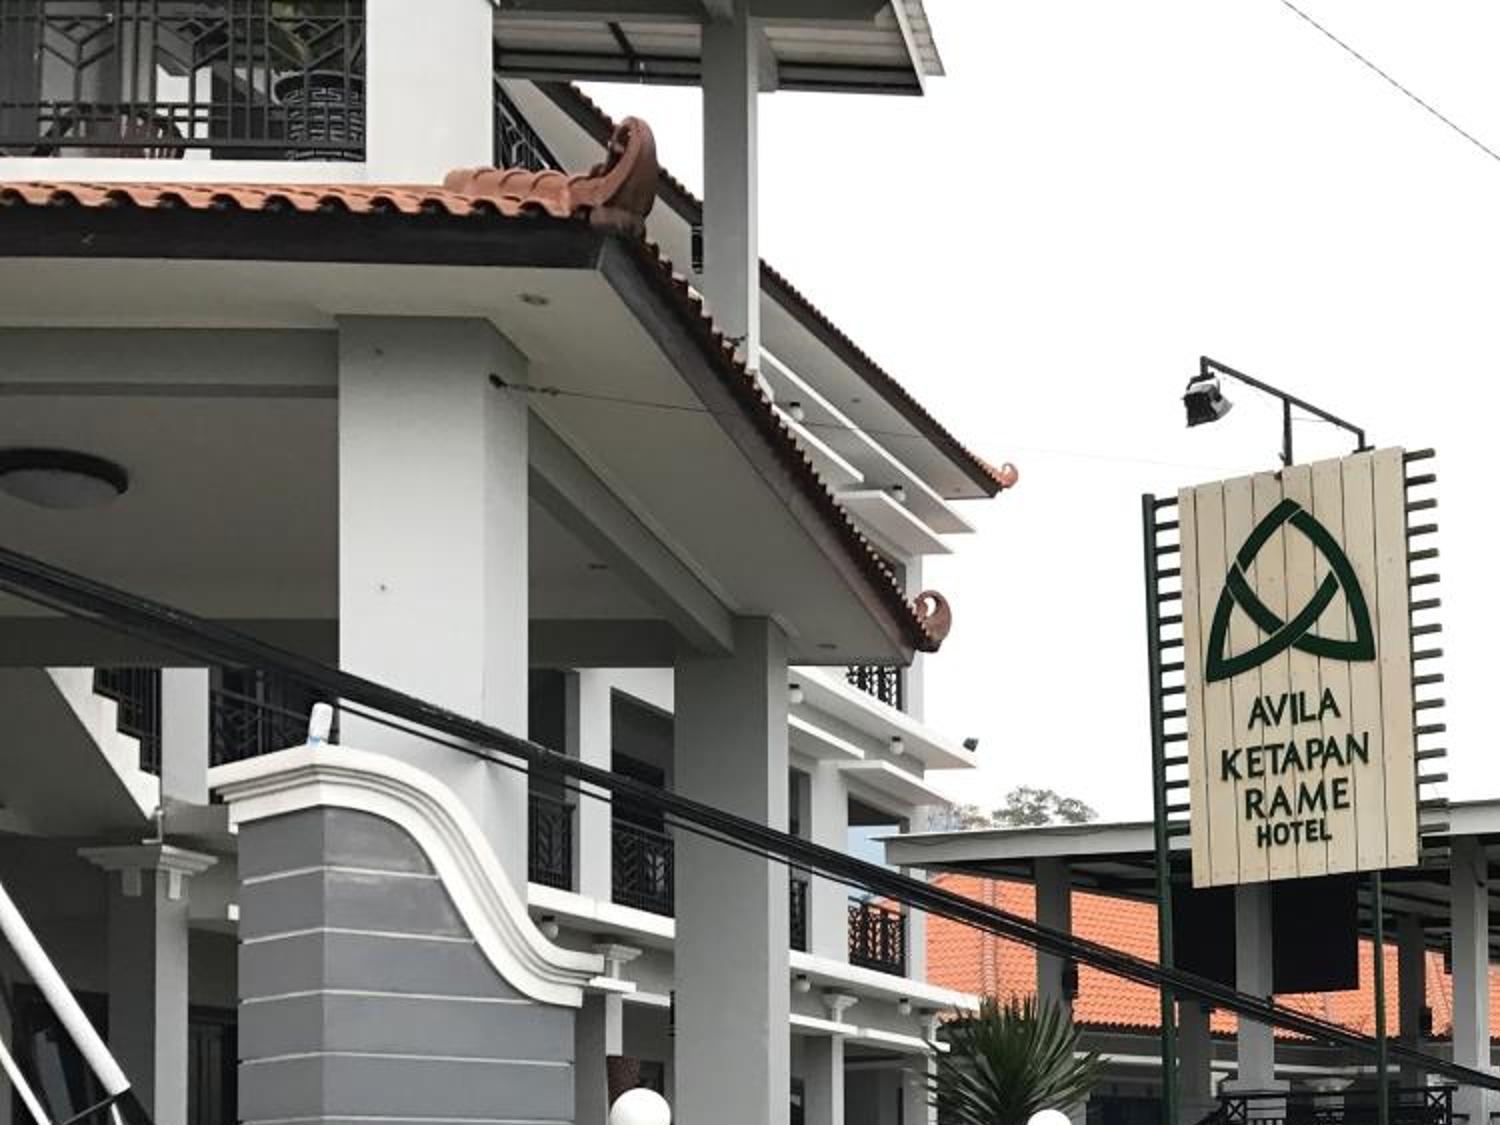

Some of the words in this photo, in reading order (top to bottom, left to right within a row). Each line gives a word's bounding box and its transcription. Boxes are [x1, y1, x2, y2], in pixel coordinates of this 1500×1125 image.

[1247, 687, 1342, 731] AVILA
[1220, 731, 1370, 782] KETAPAN
[1245, 776, 1351, 821] RAME
[1256, 818, 1333, 849] HOTEL
